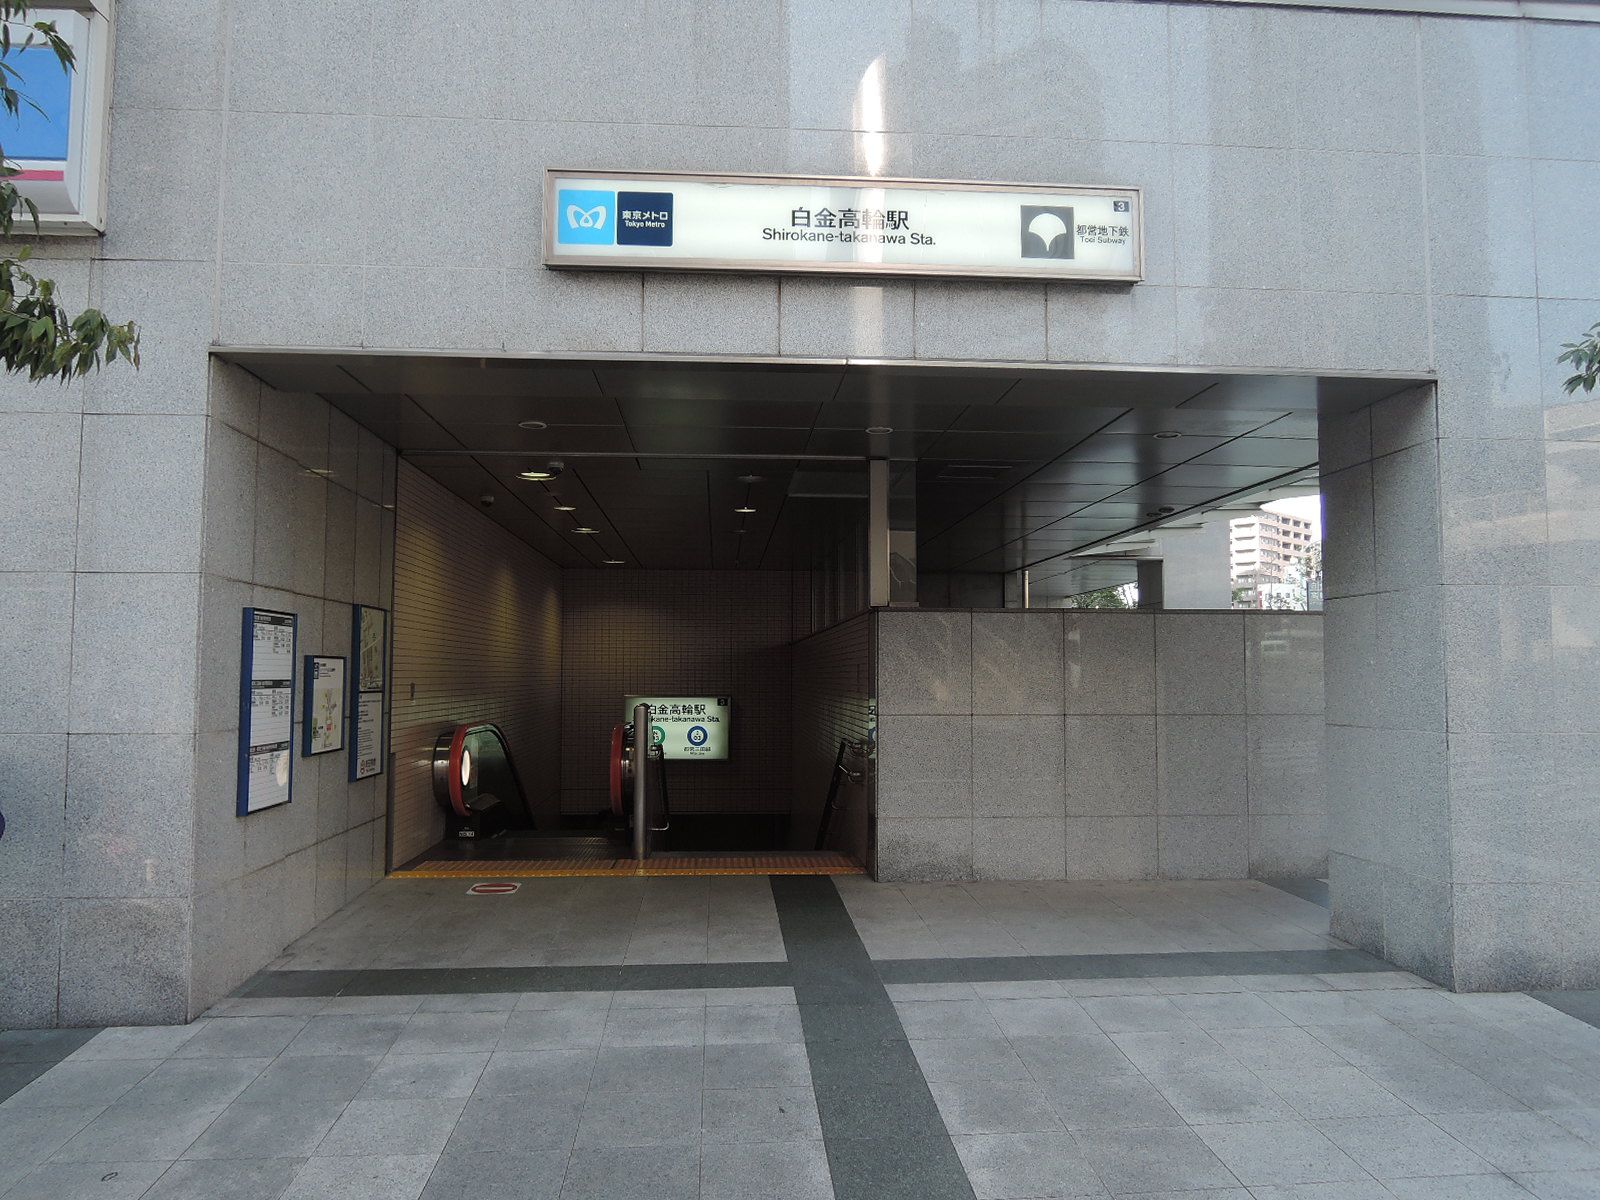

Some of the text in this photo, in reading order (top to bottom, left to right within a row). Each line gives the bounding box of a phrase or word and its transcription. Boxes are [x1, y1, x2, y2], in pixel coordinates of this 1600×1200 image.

[1118, 202, 1125, 211] 3
[622, 210, 669, 220] 東京メトロ
[791, 206, 910, 231] 白金高輪駅
[624, 220, 645, 229] Tokyo
[1076, 224, 1129, 237] 都営地下鉄
[762, 227, 936, 246] Shirokane-takanawa Sta.
[1080, 235, 1126, 245] Toei Subway
[648, 704, 706, 715] 白金高輪駅
[650, 715, 705, 723] kane-takanawa
